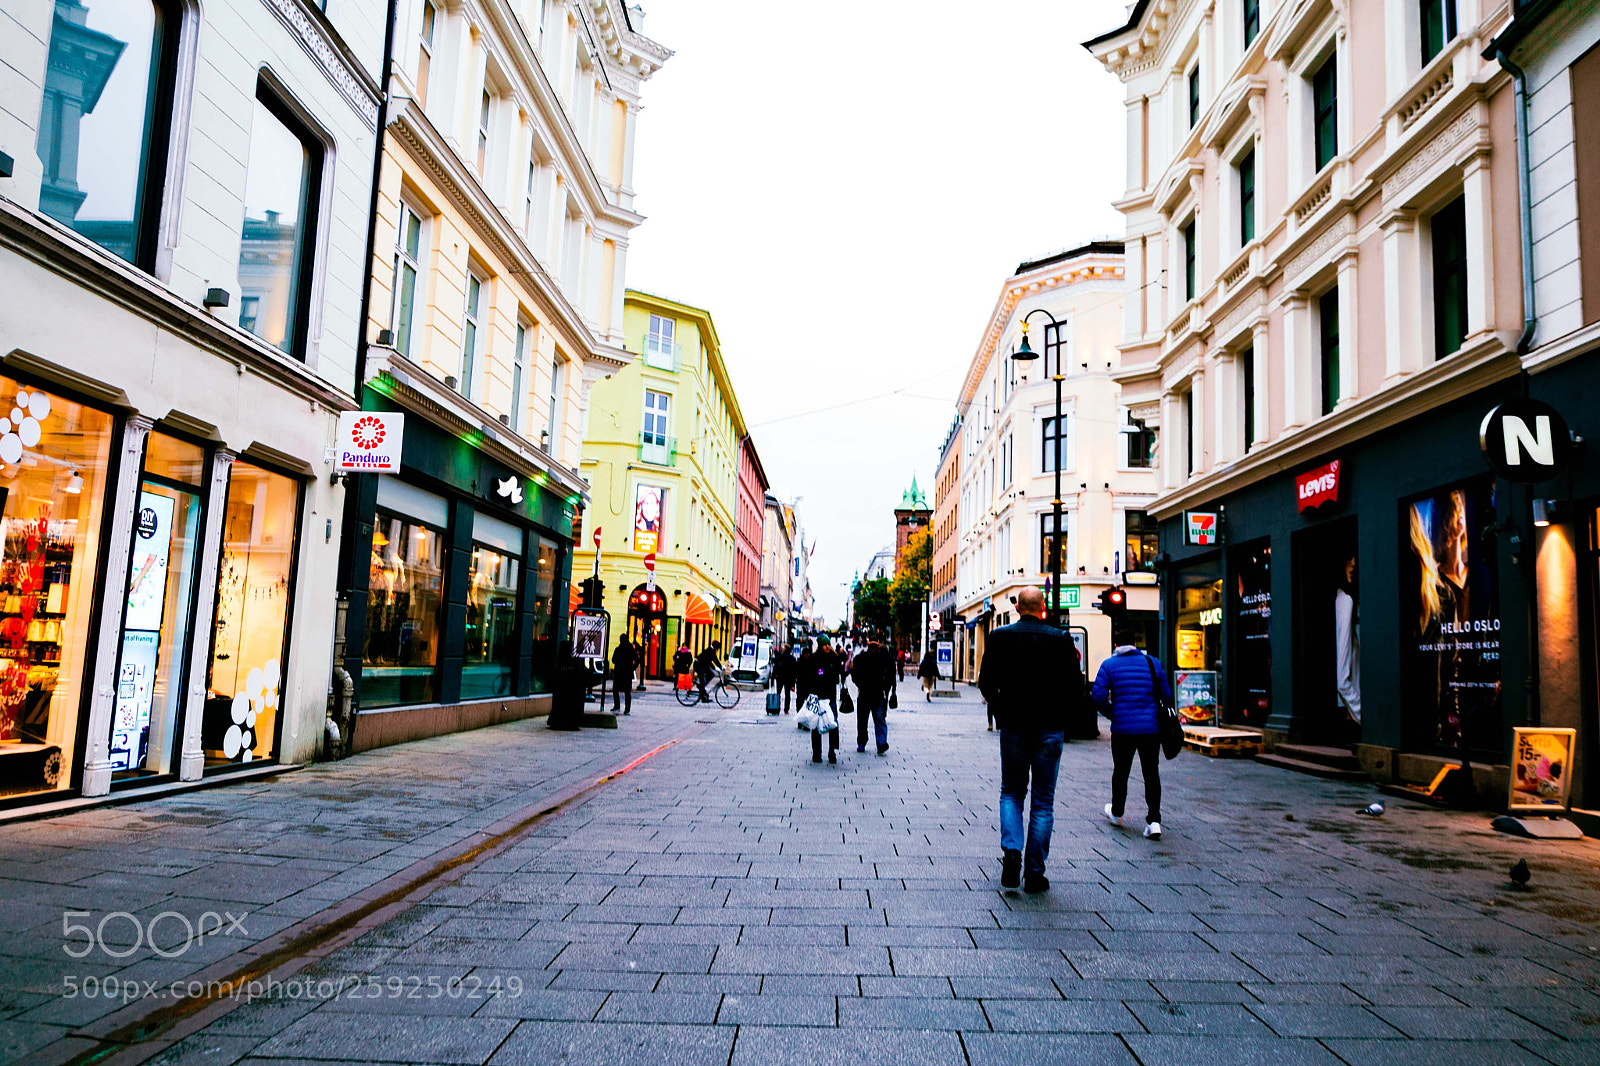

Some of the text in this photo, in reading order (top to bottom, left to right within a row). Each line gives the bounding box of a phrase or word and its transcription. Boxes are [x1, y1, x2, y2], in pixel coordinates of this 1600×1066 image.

[1502, 415, 1554, 465] N
[342, 451, 390, 463] Panduro
[141, 509, 155, 522] DIY
[1192, 515, 1214, 545] 7
[1440, 619, 1501, 634] HELLO OSLO
[1455, 642, 1473, 650] STORE
